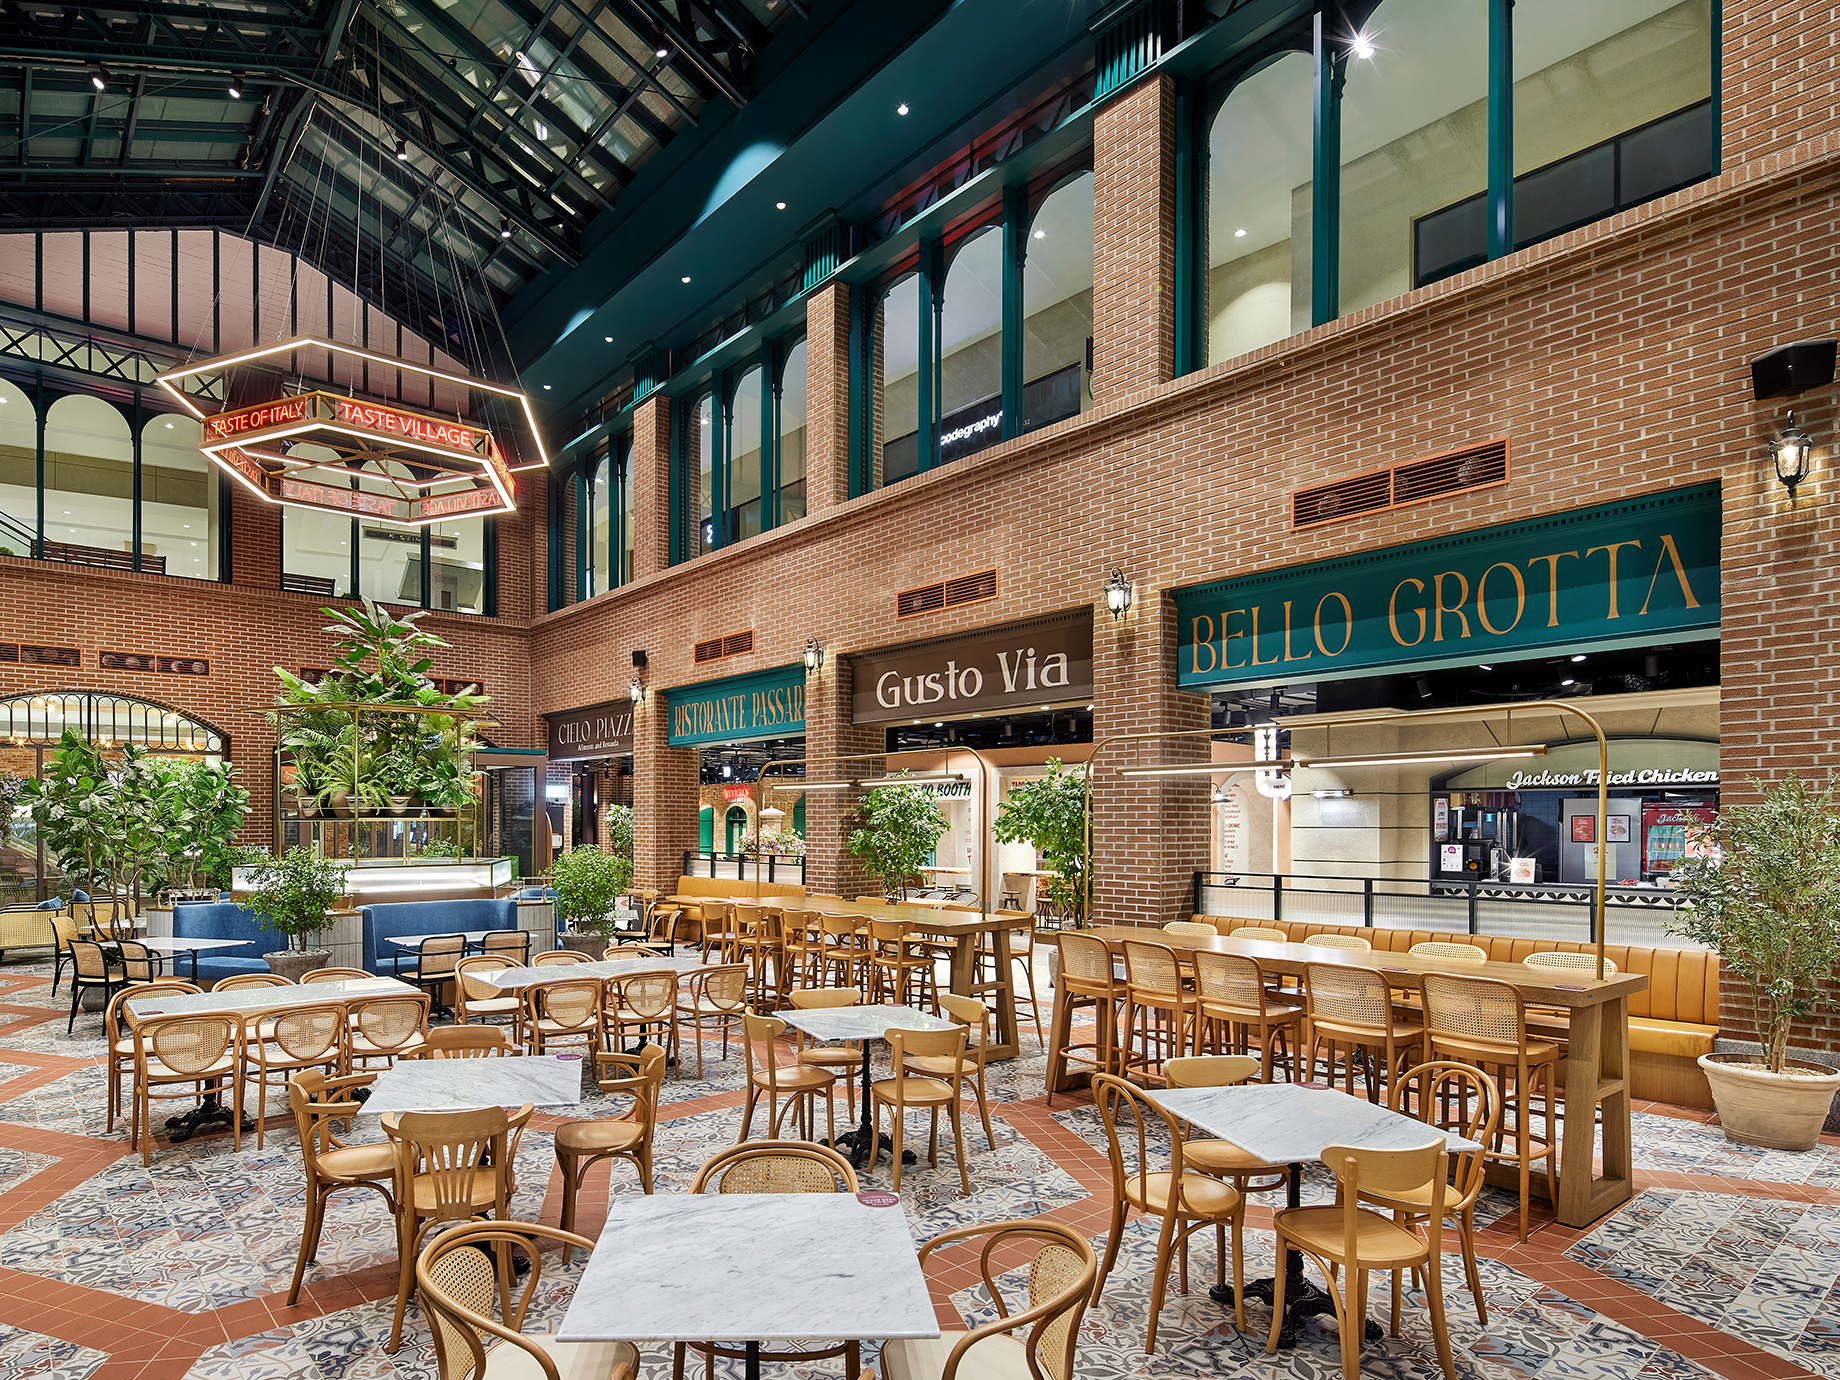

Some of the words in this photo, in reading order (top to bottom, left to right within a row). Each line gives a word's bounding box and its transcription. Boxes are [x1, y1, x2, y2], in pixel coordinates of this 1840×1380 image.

[212, 414, 249, 434] TASTE
[250, 409, 268, 427] OF
[270, 402, 304, 423] ITALY
[341, 403, 396, 430] TASTE
[399, 416, 470, 446] VILLAGE
[1190, 591, 1353, 675] BELLO
[1387, 533, 1702, 648] GROTTA
[876, 660, 984, 709] Gusto
[996, 647, 1071, 694] Via
[558, 720, 591, 745] CIELO
[596, 713, 634, 740] PIAZZ
[674, 694, 747, 737] RISTORANTE
[937, 781, 972, 797] BOOTH
[1506, 769, 1583, 790] Jackson
[1637, 767, 1720, 784] Chicken
